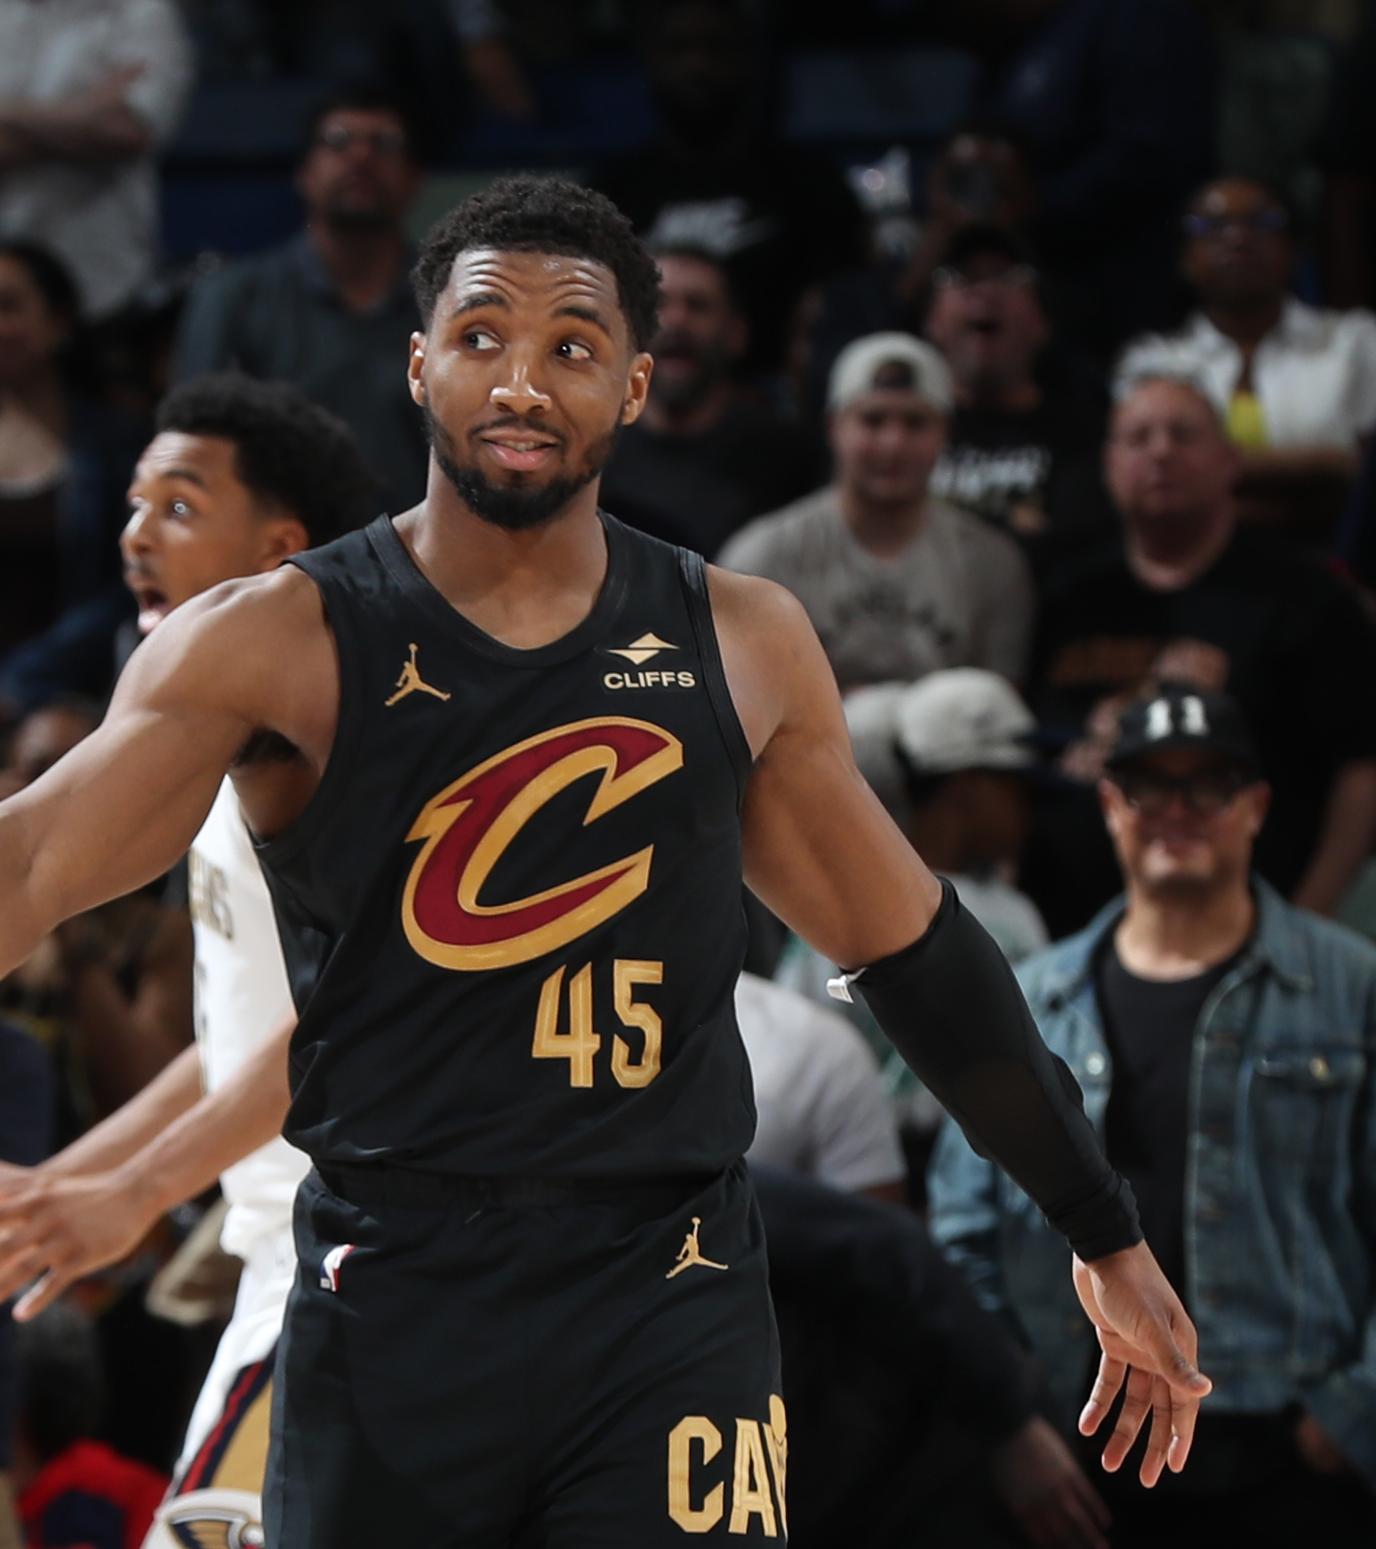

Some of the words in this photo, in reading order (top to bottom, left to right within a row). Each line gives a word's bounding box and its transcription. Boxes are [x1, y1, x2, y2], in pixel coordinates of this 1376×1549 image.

[603, 671, 696, 689] CLIFFS
[400, 715, 684, 972] C
[531, 958, 663, 1088] 45
